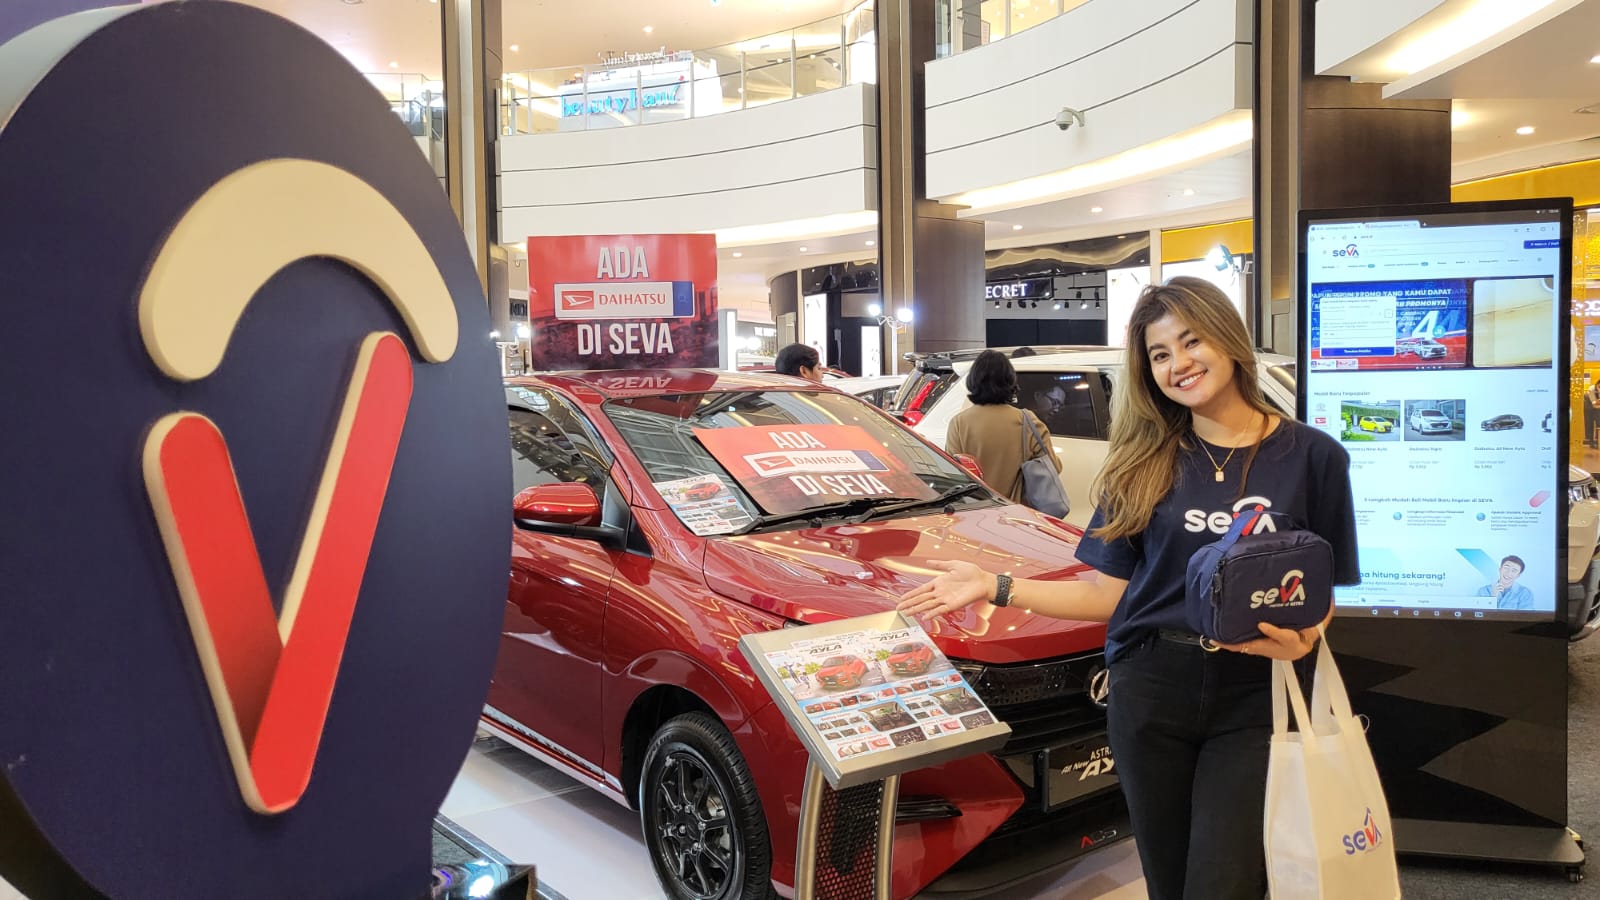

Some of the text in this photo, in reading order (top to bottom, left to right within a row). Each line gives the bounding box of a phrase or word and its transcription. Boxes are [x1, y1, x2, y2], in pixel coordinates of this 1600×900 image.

[597, 246, 649, 278] ADA
[599, 293, 666, 305] DAIHATSU
[577, 322, 674, 355] DI SEVA
[768, 431, 827, 450] ADA
[794, 455, 857, 466] DAIHATSU
[789, 474, 894, 497] DI SEVA
[1372, 571, 1400, 580] hitung
[1401, 572, 1446, 581] sekarang!
[879, 631, 910, 642] AYLA
[809, 644, 842, 655] AYLA
[1090, 746, 1112, 761] ASTR
